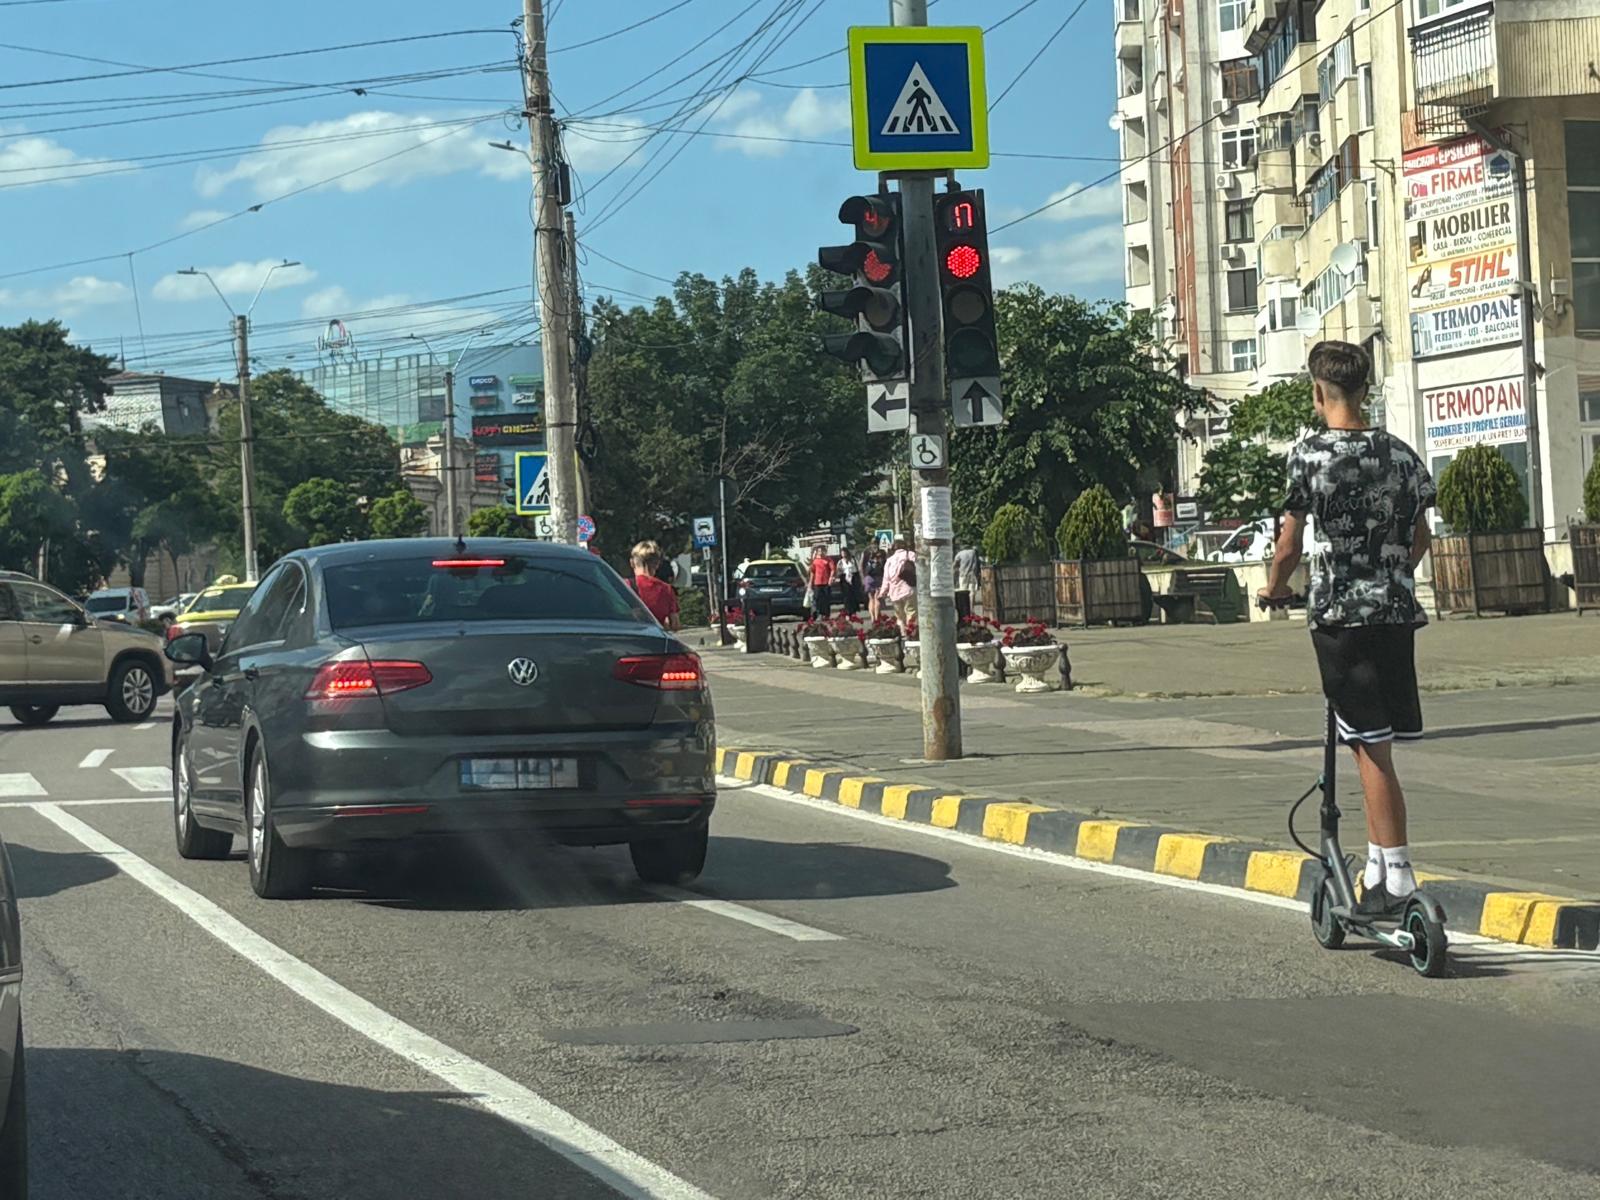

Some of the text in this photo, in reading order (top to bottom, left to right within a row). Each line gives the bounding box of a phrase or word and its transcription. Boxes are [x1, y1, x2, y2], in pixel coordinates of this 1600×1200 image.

[1432, 163, 1484, 194] FIRME
[1432, 202, 1511, 240] MOBILIER
[1449, 251, 1510, 287] STIHL
[1431, 299, 1519, 331] TERMOPANE
[1484, 319, 1519, 334] BALCOANE
[1425, 381, 1522, 422] TERMOPAN
[696, 534, 715, 546] TAXI
